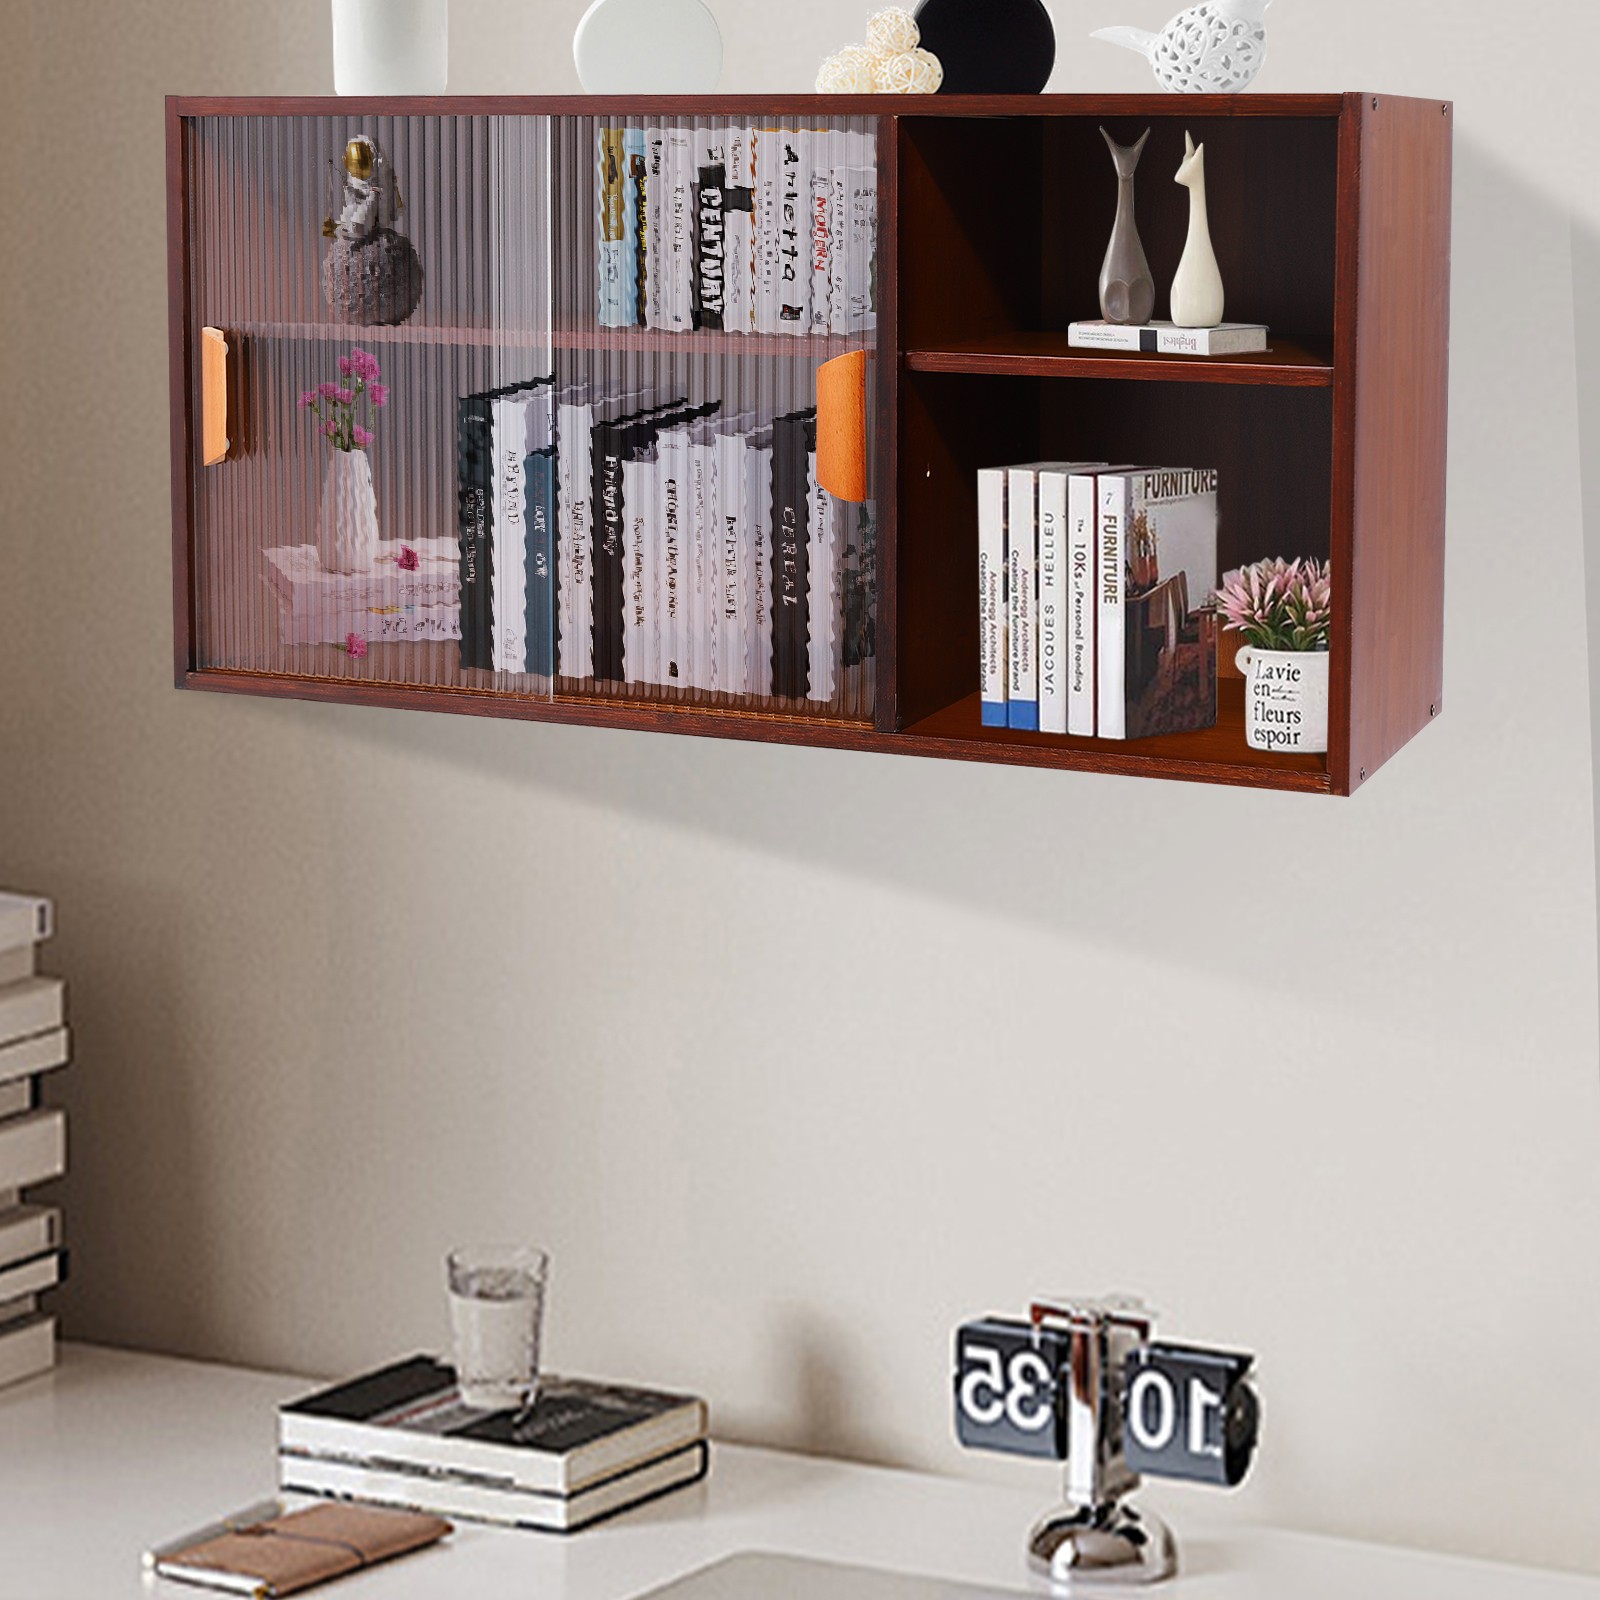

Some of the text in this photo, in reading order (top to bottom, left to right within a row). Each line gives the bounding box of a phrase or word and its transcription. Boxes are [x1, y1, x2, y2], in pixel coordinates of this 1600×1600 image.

[700, 186, 723, 314] CENTURY
[814, 197, 828, 271] MODERN
[1163, 334, 1197, 350] Brightest
[1144, 469, 1216, 499] FURNITURE
[781, 506, 798, 606] CEREAL
[1074, 543, 1087, 578] 10Ks
[1103, 514, 1118, 604] FURNITURE
[980, 552, 989, 693] Creating the furniture brand
[989, 571, 997, 620] Anderegg
[1010, 549, 1020, 691] Creating the furniture brand
[1020, 568, 1030, 673] Anderegg Architects
[1044, 512, 1055, 695] JACQUES HELLEU
[1075, 591, 1084, 640] Personal
[1073, 644, 1084, 692] Branding
[1253, 700, 1301, 724] fleurs
[1253, 726, 1301, 749] espoir
